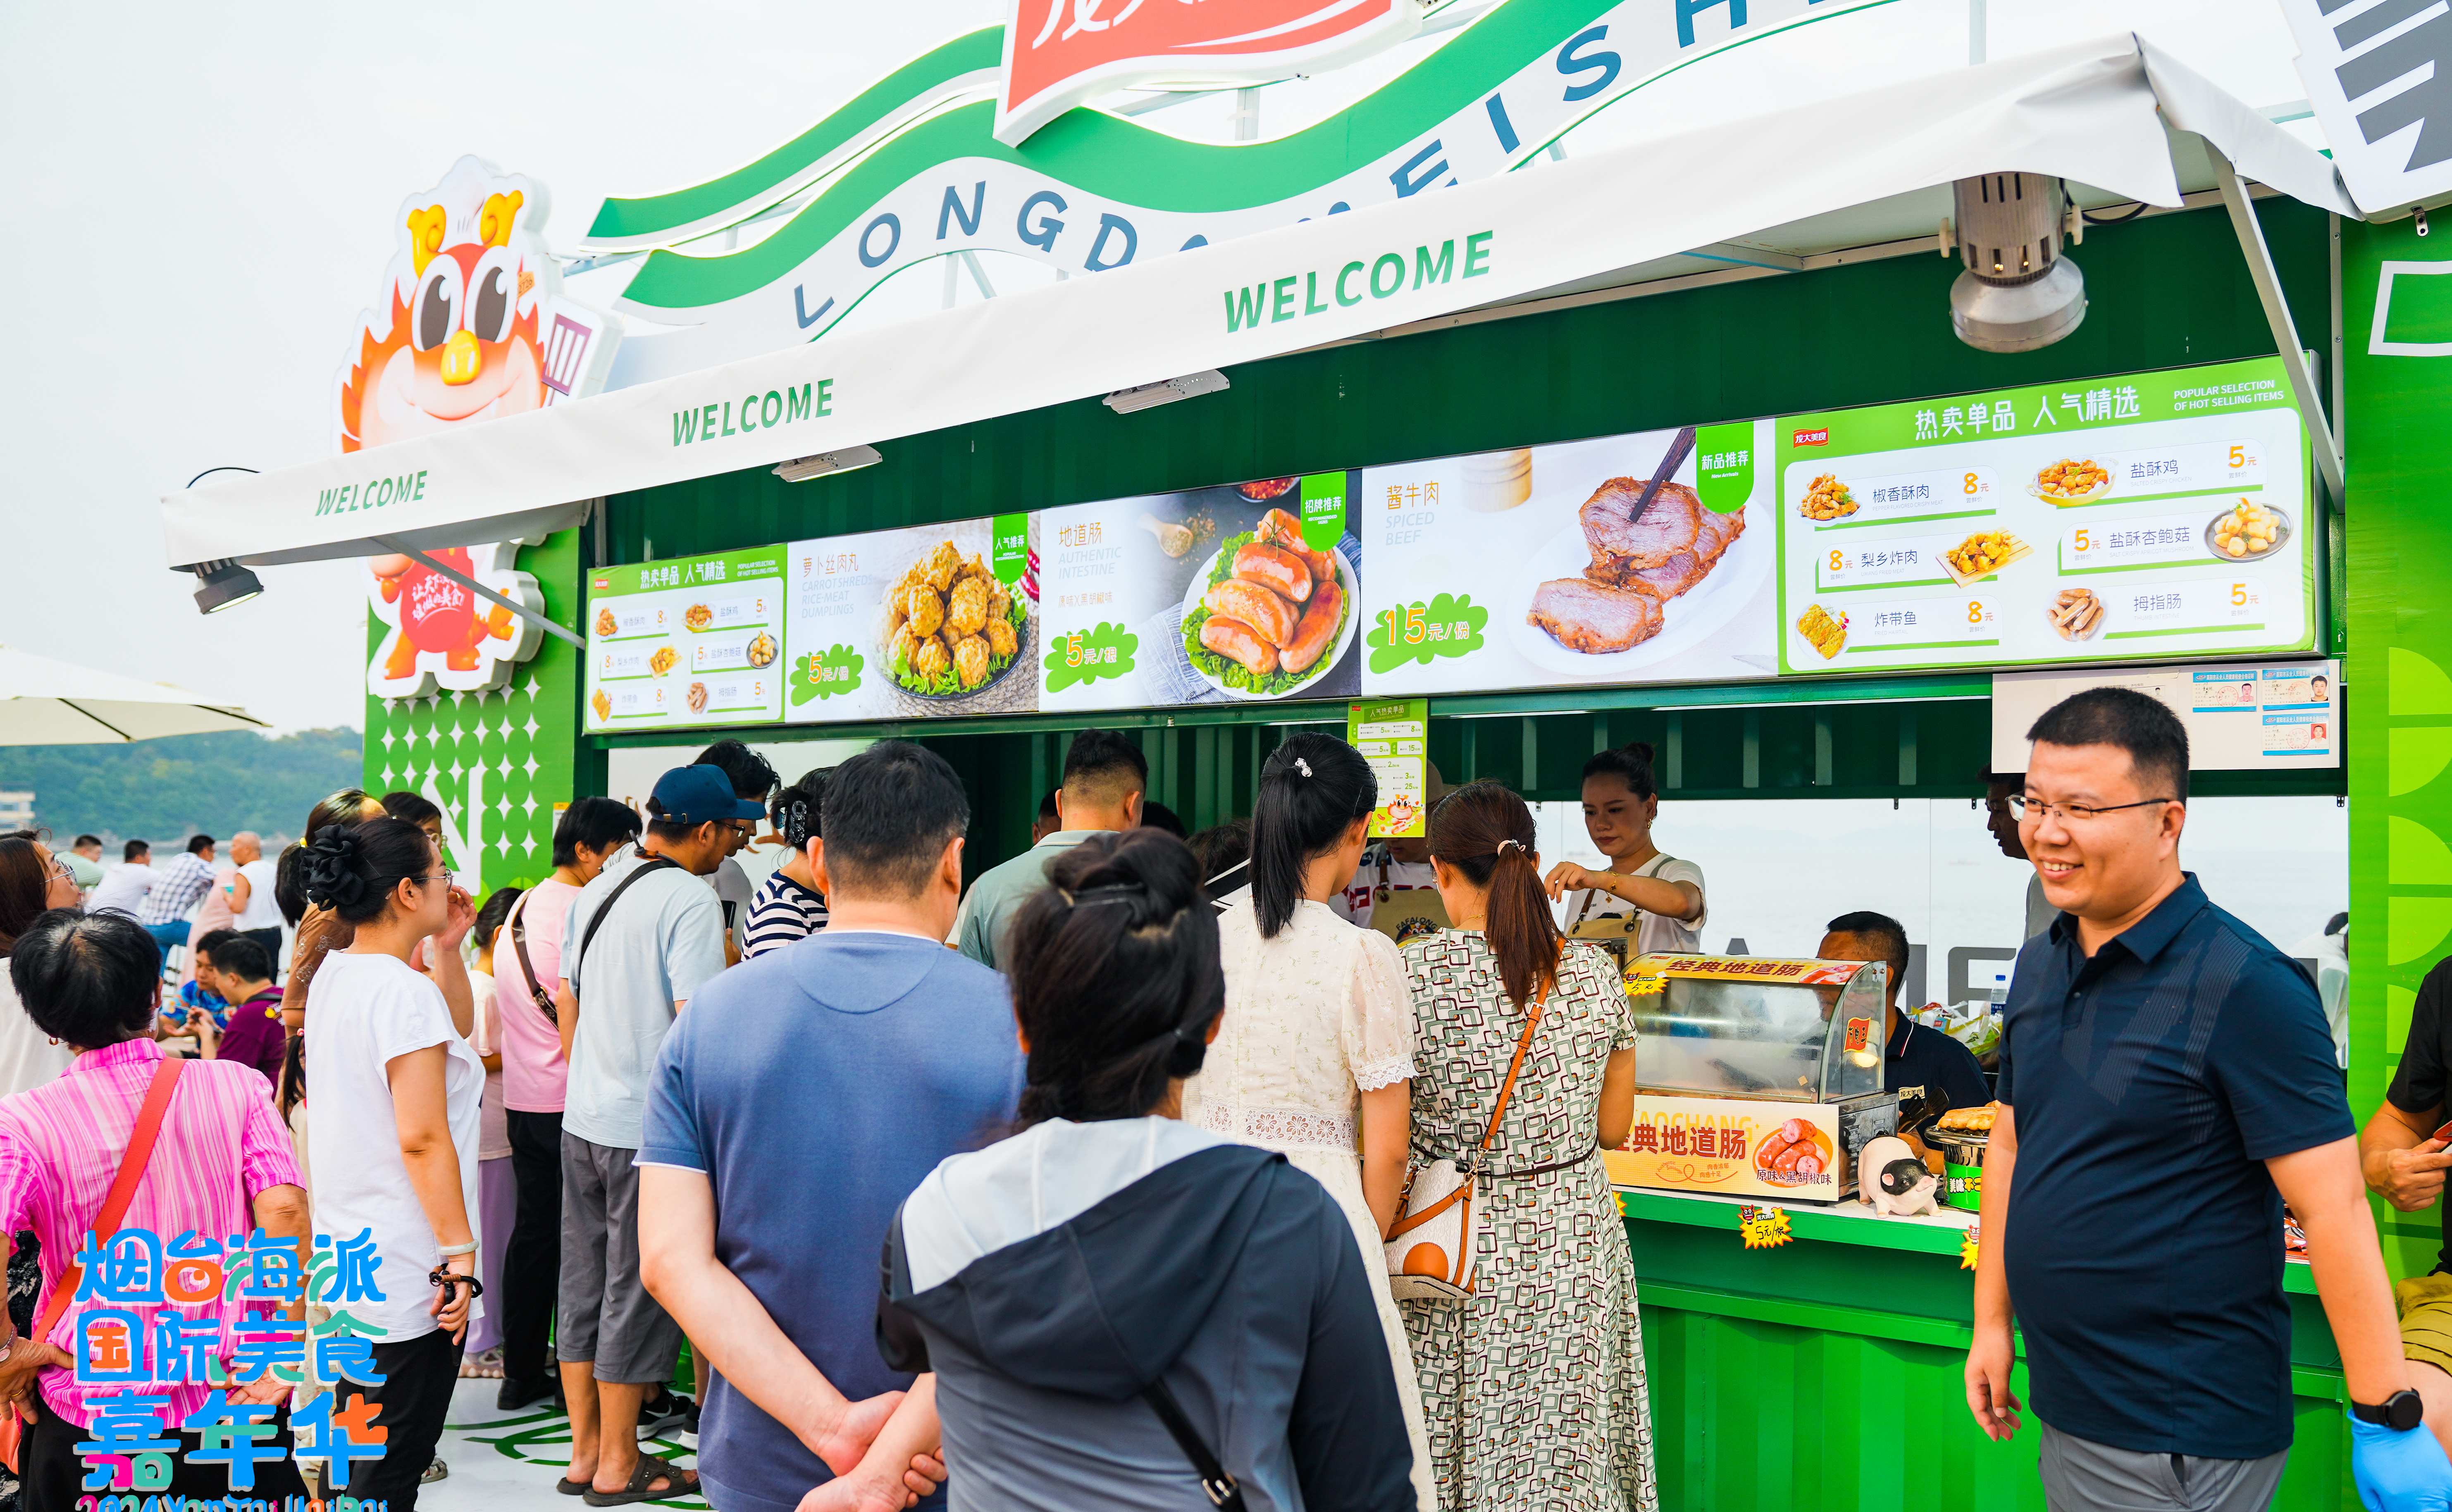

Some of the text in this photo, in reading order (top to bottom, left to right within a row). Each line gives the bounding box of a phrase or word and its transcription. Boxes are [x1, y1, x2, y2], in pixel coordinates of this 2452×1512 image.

[794, 181, 1209, 329] LONGD
[1224, 229, 1495, 333] WELCOME
[2174, 379, 2275, 399] POPULAR SELECTION
[2174, 390, 2284, 411] OF HOT SELLING ITEMS
[673, 378, 834, 447] WELCOME
[1915, 385, 2140, 441] 热卖单品 人气精选
[1795, 431, 1827, 444] 龙大美食
[1701, 449, 1748, 471] 新品推荐
[2228, 445, 2257, 469] 5元
[2130, 459, 2179, 478] 盐酥鸡
[315, 470, 428, 516] WELCOME
[1872, 484, 1930, 503] 椒香酥肉
[1963, 472, 1989, 494] 8元
[1305, 496, 1342, 514] 招牌推荐
[1386, 479, 1439, 510] 酱牛肉
[1386, 511, 1435, 529] SPICED
[995, 535, 1024, 550] 人气推荐
[1059, 522, 1102, 547] 地道肠
[1386, 529, 1421, 546] BEEF
[2073, 529, 2100, 551] 5元
[2109, 527, 2190, 549] 盐酥杏鲍菇
[803, 552, 859, 577] 萝卜丝肉丸
[1059, 546, 1121, 565] AUTHENTIC
[1829, 550, 1853, 571] 8元
[1861, 549, 1918, 568] 梨乡炸肉
[640, 560, 725, 589] 热卖单品 人气精选
[1059, 563, 1115, 579] INTESTINE
[802, 591, 849, 605] RICE-MEAT
[2134, 593, 2181, 612] 拇指肠
[2231, 583, 2259, 606] 5元
[802, 604, 854, 618] DUMPLINGS
[1875, 611, 1917, 627] 炸带鱼
[1968, 601, 1993, 623] 8元
[1384, 607, 1470, 646] 15元/份
[1066, 635, 1117, 668] 5元/根
[1370, 705, 1404, 718] 人气热卖单品
[1396, 916, 1437, 931] FAFALONG
[1666, 960, 1805, 976] 经典地道肠
[1757, 1169, 1832, 1186] 原味&黑胡椒味
